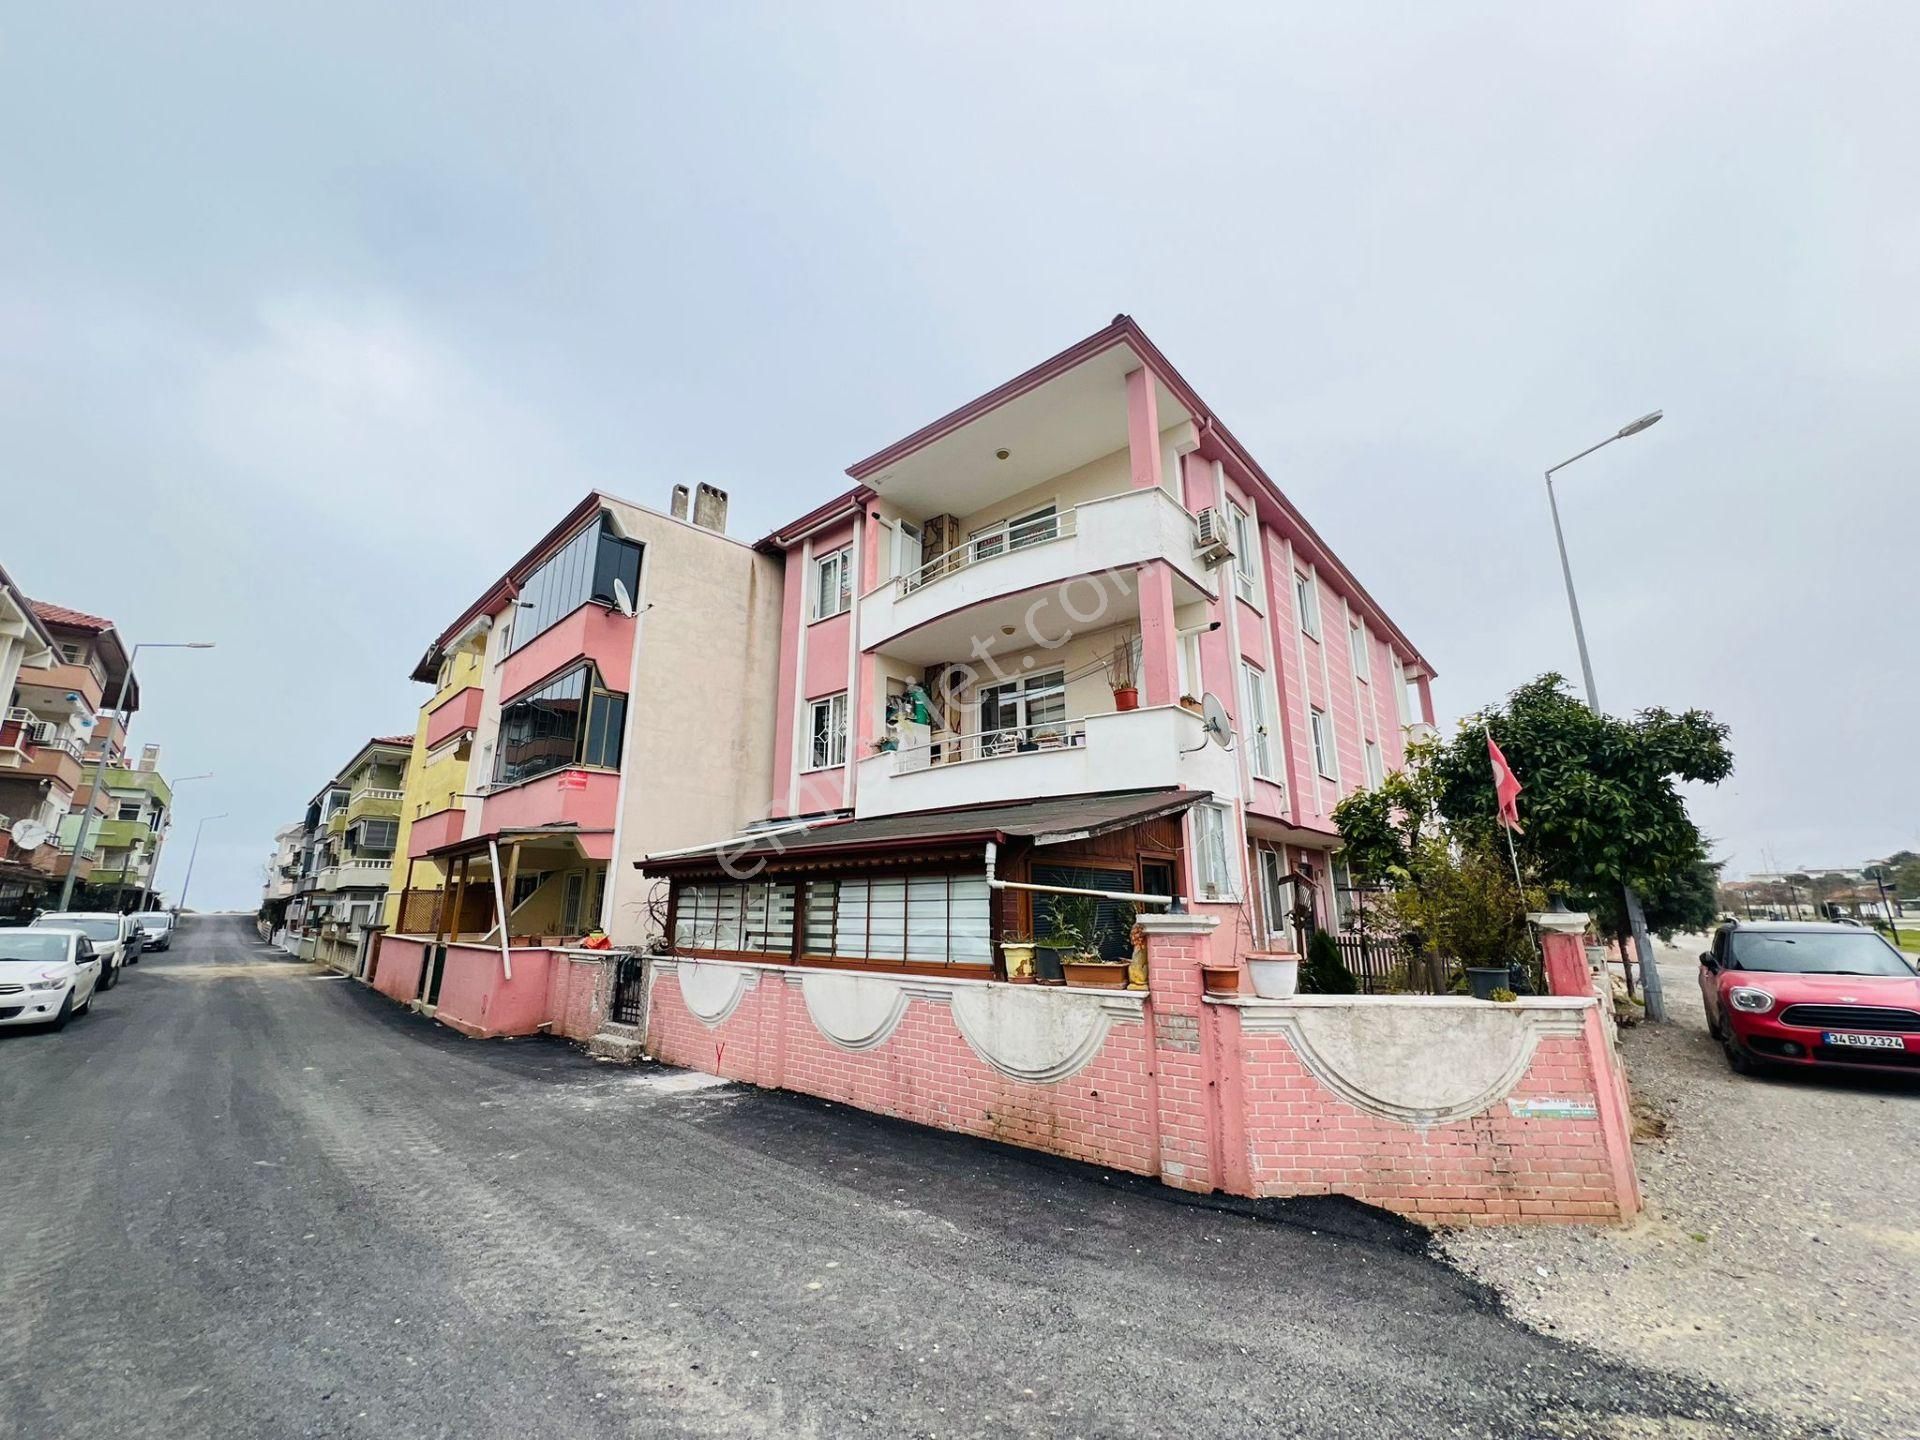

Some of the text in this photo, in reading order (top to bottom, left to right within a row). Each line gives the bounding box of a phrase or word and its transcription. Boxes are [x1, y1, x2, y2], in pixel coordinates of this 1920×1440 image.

[1830, 1033, 1846, 1044] 34
[1848, 1035, 1868, 1045] BU
[1869, 1036, 1902, 1047] 2324
